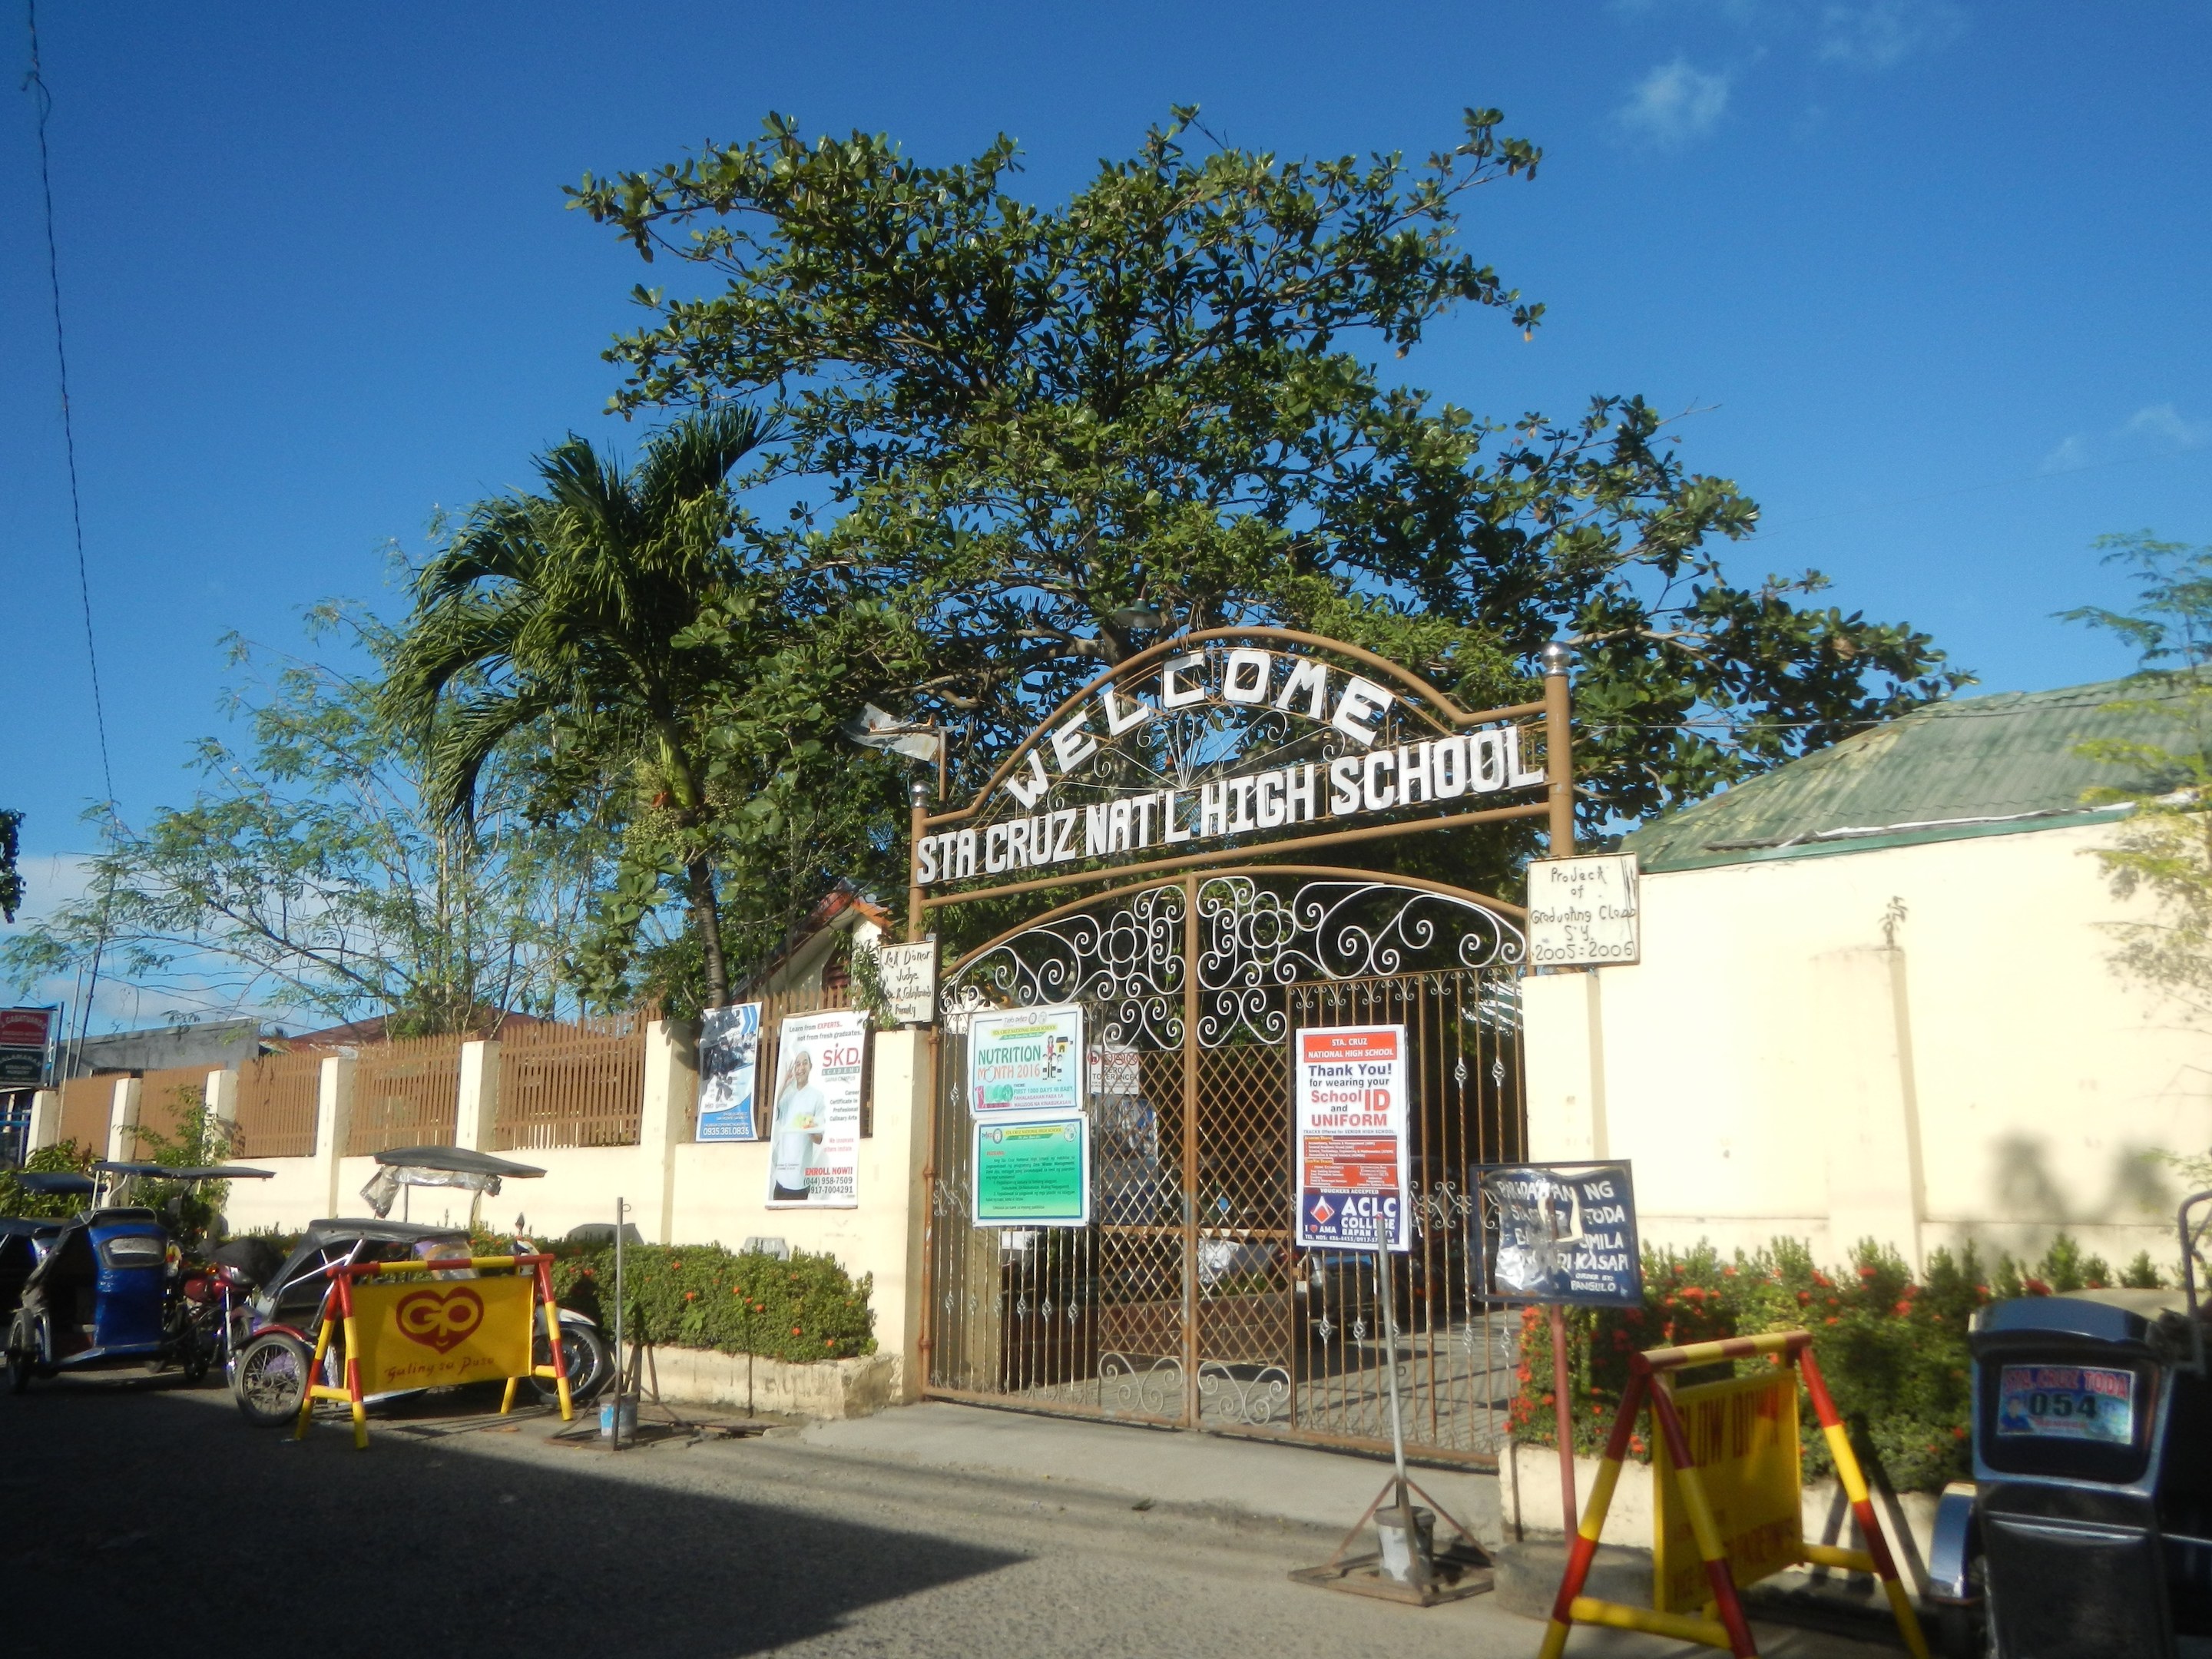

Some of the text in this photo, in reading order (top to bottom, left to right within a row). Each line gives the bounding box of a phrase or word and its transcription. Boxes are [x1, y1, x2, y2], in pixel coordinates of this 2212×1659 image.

[1005, 649, 1396, 810] WELCOME
[916, 725, 1545, 886] STA CRUZ NAT'L HIGH SCHOOL
[1571, 885, 1584, 899] of
[1531, 906, 1591, 924] Graduating
[896, 967, 919, 984] Judge
[978, 1045, 1041, 1066] NUTRITION
[978, 1063, 1040, 1083] MONTH 2016
[1308, 1063, 1392, 1076] Thank You!
[1310, 1078, 1389, 1088] for wearing your
[1311, 1088, 1391, 1111] School ID
[1311, 1113, 1387, 1127] UNIFORM
[805, 1167, 853, 1176] ENROLL NOW!!
[803, 1177, 820, 1186] (044)
[1584, 1181, 1614, 1200] NG
[1341, 1196, 1396, 1217] ACLC
[385, 1363, 435, 1382] Galing
[459, 1356, 495, 1376] Puso
[2037, 1369, 2078, 1389] CRUZ
[2083, 1370, 2128, 1399] TODA
[2029, 1392, 2098, 1419] 054
